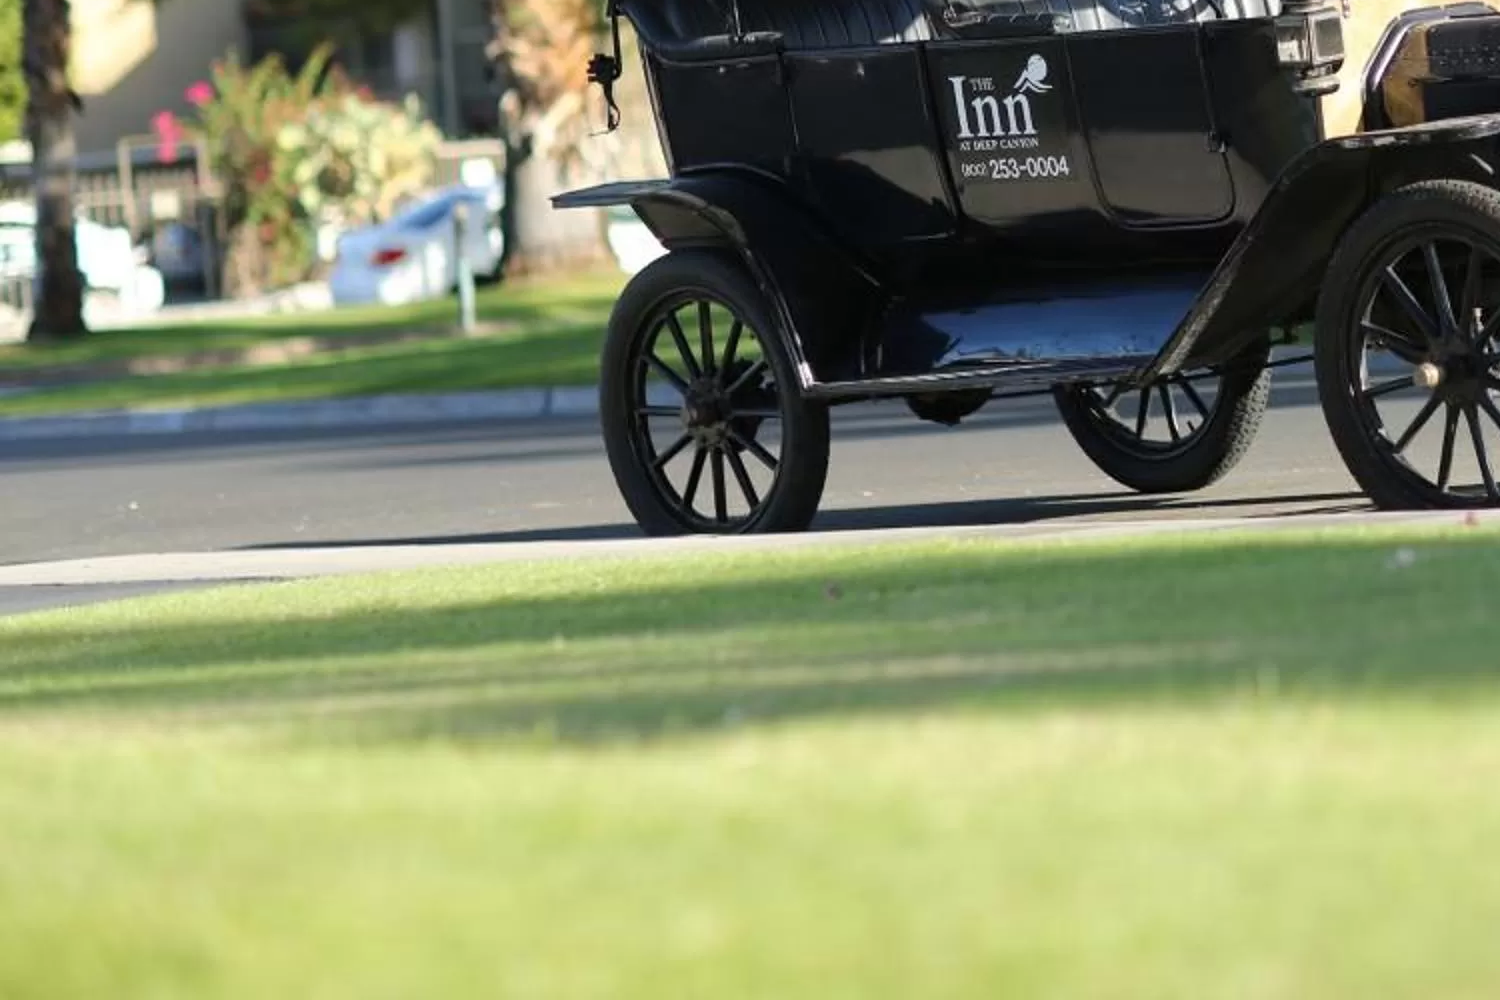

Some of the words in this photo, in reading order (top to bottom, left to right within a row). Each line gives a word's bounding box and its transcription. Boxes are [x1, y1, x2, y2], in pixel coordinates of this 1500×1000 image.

[969, 77, 995, 91] THE
[948, 76, 1037, 138] Inn
[999, 137, 1039, 149] CANYON
[989, 155, 1069, 179] 253-0004
